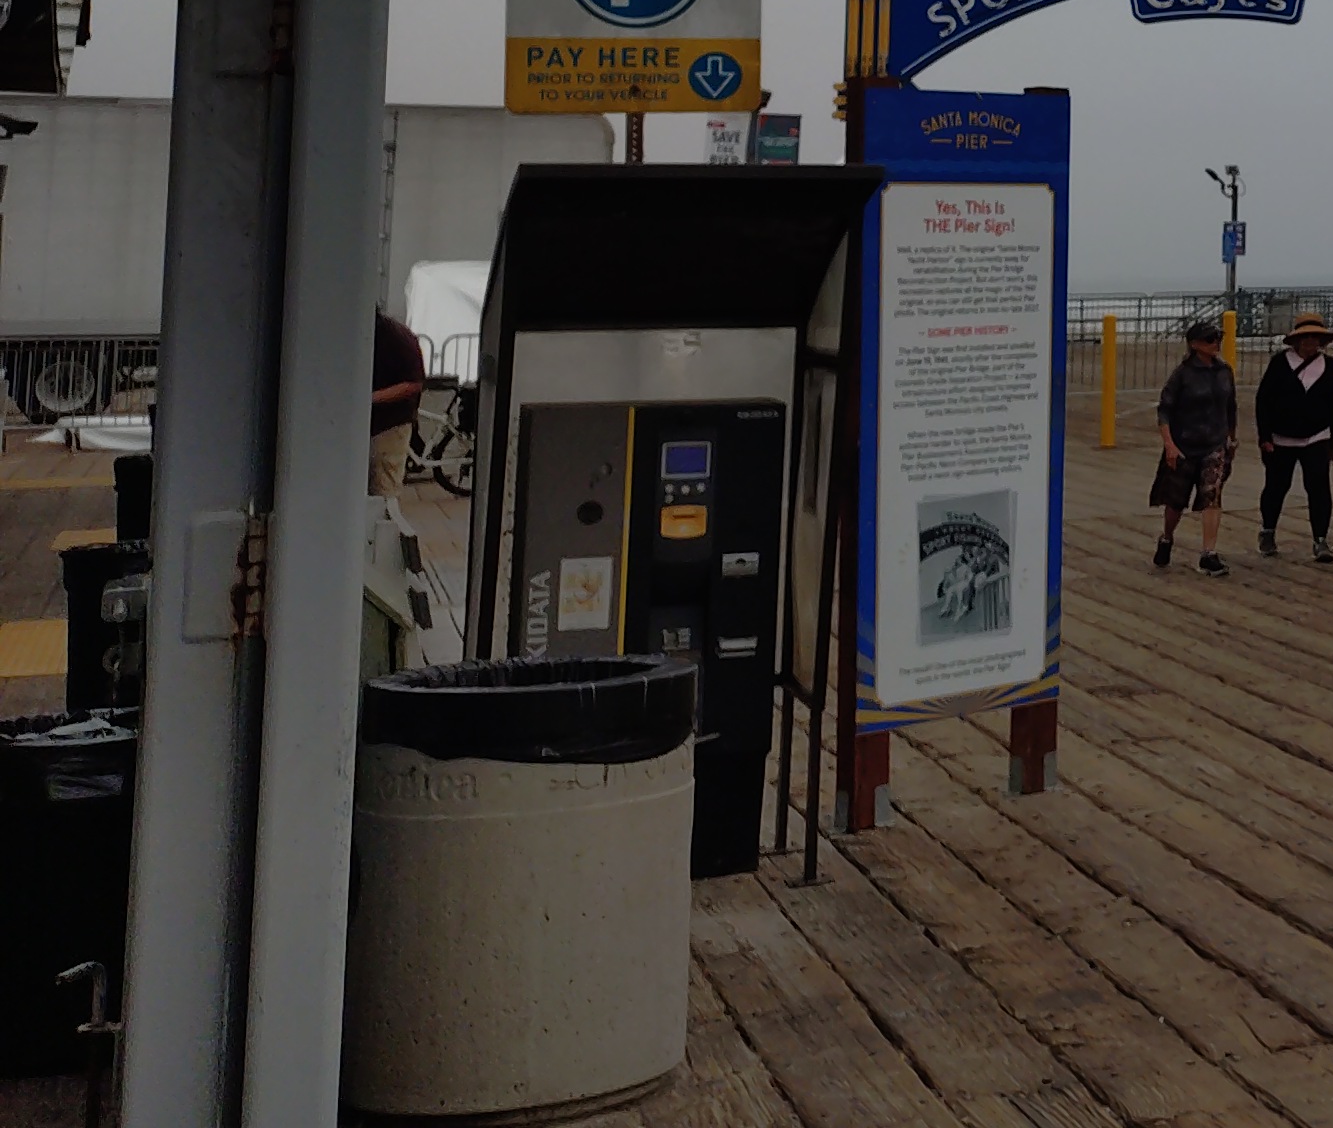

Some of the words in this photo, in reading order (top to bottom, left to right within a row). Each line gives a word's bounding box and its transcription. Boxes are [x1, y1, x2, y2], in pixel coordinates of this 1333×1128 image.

[527, 47, 585, 68] PAY
[599, 47, 681, 68] HERE
[527, 72, 572, 85] PRIOR
[576, 72, 595, 85] TO
[599, 72, 681, 85] RETURNING
[538, 88, 559, 101] TO
[564, 89, 606, 102] YOUR
[920, 111, 963, 136] SANTA
[968, 110, 1022, 139] MONICA
[955, 133, 989, 150] PIER
[935, 199, 961, 217] Yes,
[965, 199, 992, 215] This
[924, 218, 951, 234] THE
[954, 218, 980, 233] Pier
[983, 217, 1016, 237] Sign!
